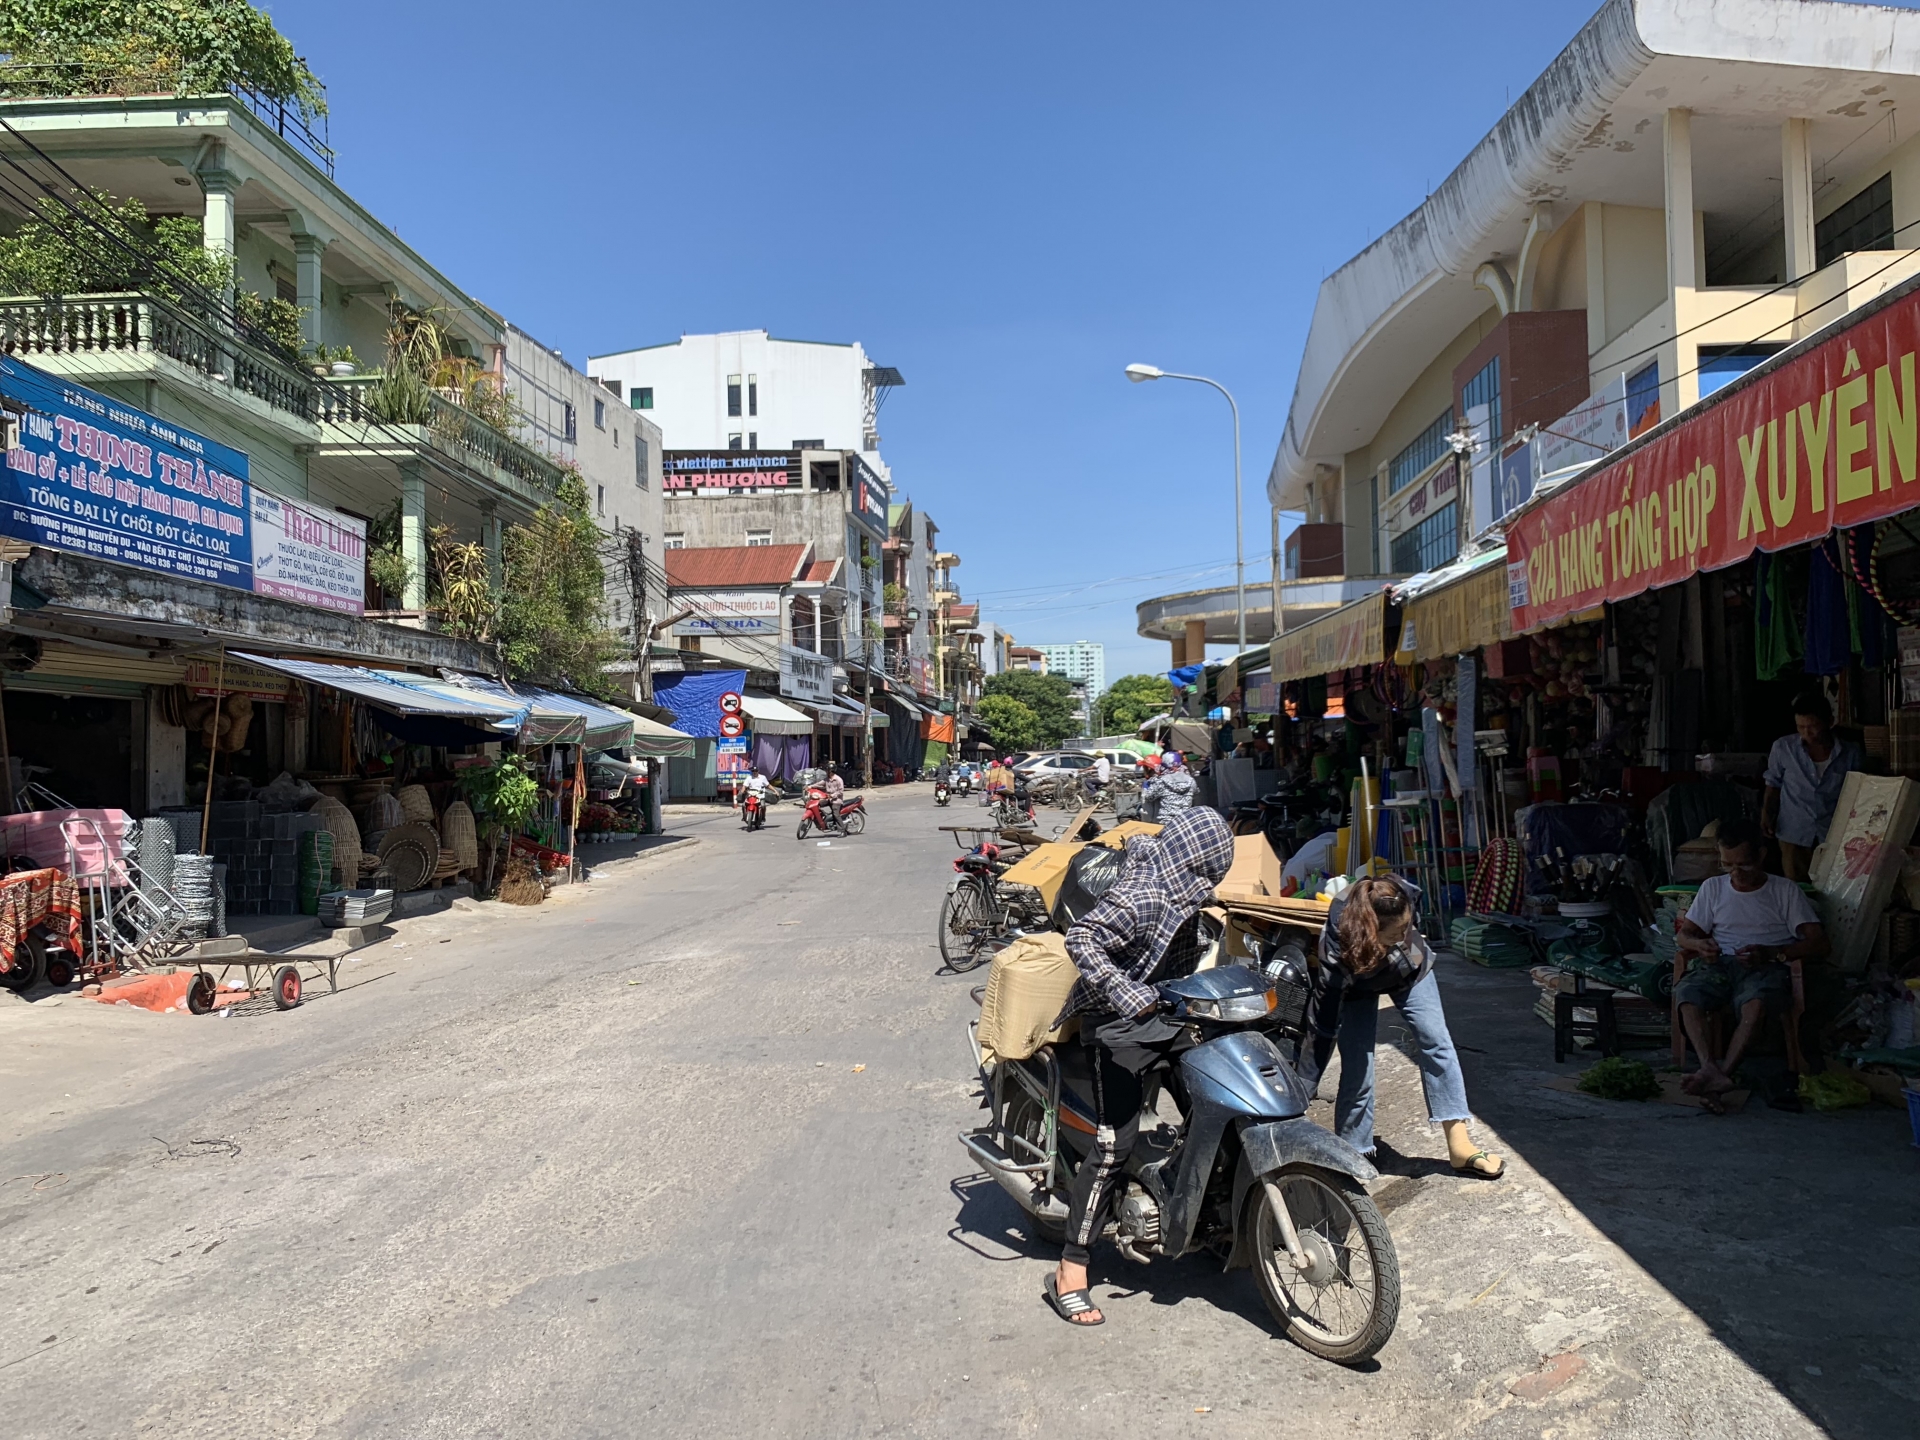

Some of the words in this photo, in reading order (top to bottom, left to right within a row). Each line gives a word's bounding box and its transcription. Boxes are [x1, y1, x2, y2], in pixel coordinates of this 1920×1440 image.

[29, 412, 54, 442] HÀNG
[180, 436, 204, 455] NGA
[1737, 348, 1917, 541] XUYÊN
[55, 414, 152, 478] THỊNH
[157, 452, 243, 508] THÀNH
[691, 471, 788, 488] PHƯƠNG
[732, 456, 788, 468] KHATOCO
[7, 445, 36, 476] BÁN
[71, 461, 87, 490] LẺ
[89, 470, 113, 498] CÁC
[115, 478, 140, 508] MẶT
[141, 485, 171, 516] HÀNG
[172, 497, 200, 525] NHỰA
[201, 506, 218, 529] GIA
[218, 511, 244, 536] DỤNG
[13, 510, 29, 522] ĐC:
[30, 513, 60, 531] ĐƯỜNG
[62, 522, 86, 538] PHẠM
[88, 529, 119, 545] NGUYỄN
[120, 537, 131, 548] DU
[136, 541, 151, 553] VÀO
[152, 543, 166, 556] BẾN
[167, 548, 177, 559] XE
[178, 550, 192, 563] CHỢ
[29, 486, 70, 512] TỔNG
[73, 500, 99, 521] ĐẠI
[103, 506, 118, 525] LÝ
[121, 513, 153, 534] CHỔI
[156, 521, 180, 540] ĐÓT
[182, 528, 203, 547] CÁC
[205, 536, 230, 556] LOẠI
[281, 502, 323, 548] Thảo
[328, 518, 362, 559] Linh
[1528, 519, 1557, 607] CỬA
[1558, 511, 1604, 598] HÀNG
[1607, 464, 1662, 582] TỔNG
[1668, 456, 1717, 571] HỢP
[46, 530, 60, 543] ĐT:
[61, 535, 86, 549] 02383
[87, 541, 102, 553] 835
[103, 544, 118, 556] 908
[124, 550, 142, 561] 0984
[143, 554, 157, 565] 545
[157, 557, 171, 568] 836
[176, 562, 193, 574] 0942
[277, 541, 297, 554] THUỐC
[262, 583, 274, 594] DĐ:
[307, 593, 318, 603] 689
[350, 586, 363, 597] INOX
[760, 598, 776, 611] LÀO
